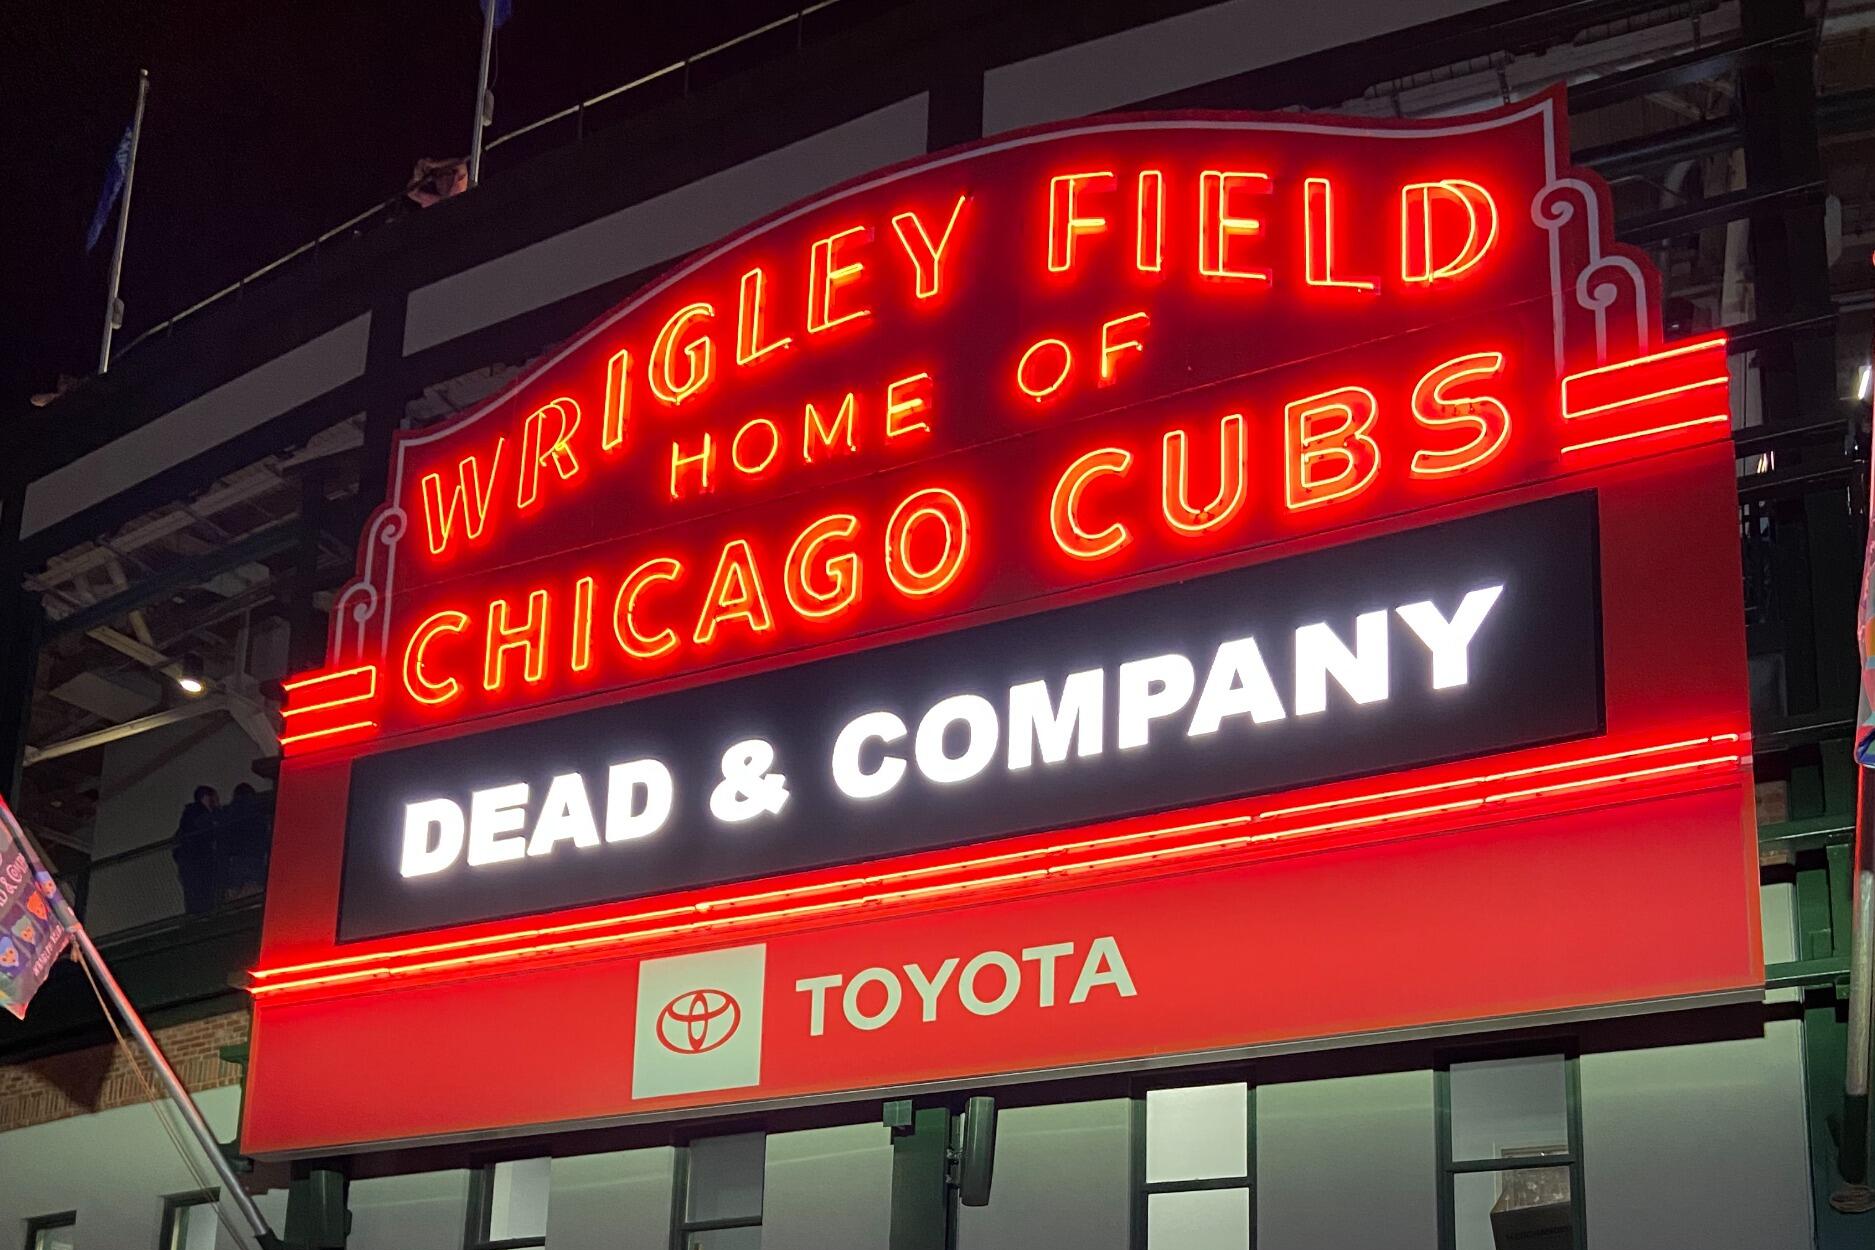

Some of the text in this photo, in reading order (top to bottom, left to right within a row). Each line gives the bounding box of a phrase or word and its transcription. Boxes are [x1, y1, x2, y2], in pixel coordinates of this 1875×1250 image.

[421, 169, 1499, 555] WRIGLEY FIELD
[671, 312, 1149, 497] HOME OF
[403, 351, 1510, 705] CHICAGO CUBS
[400, 584, 1503, 878] DEAD & COMPANY
[795, 936, 1137, 1036] TOYOTA
